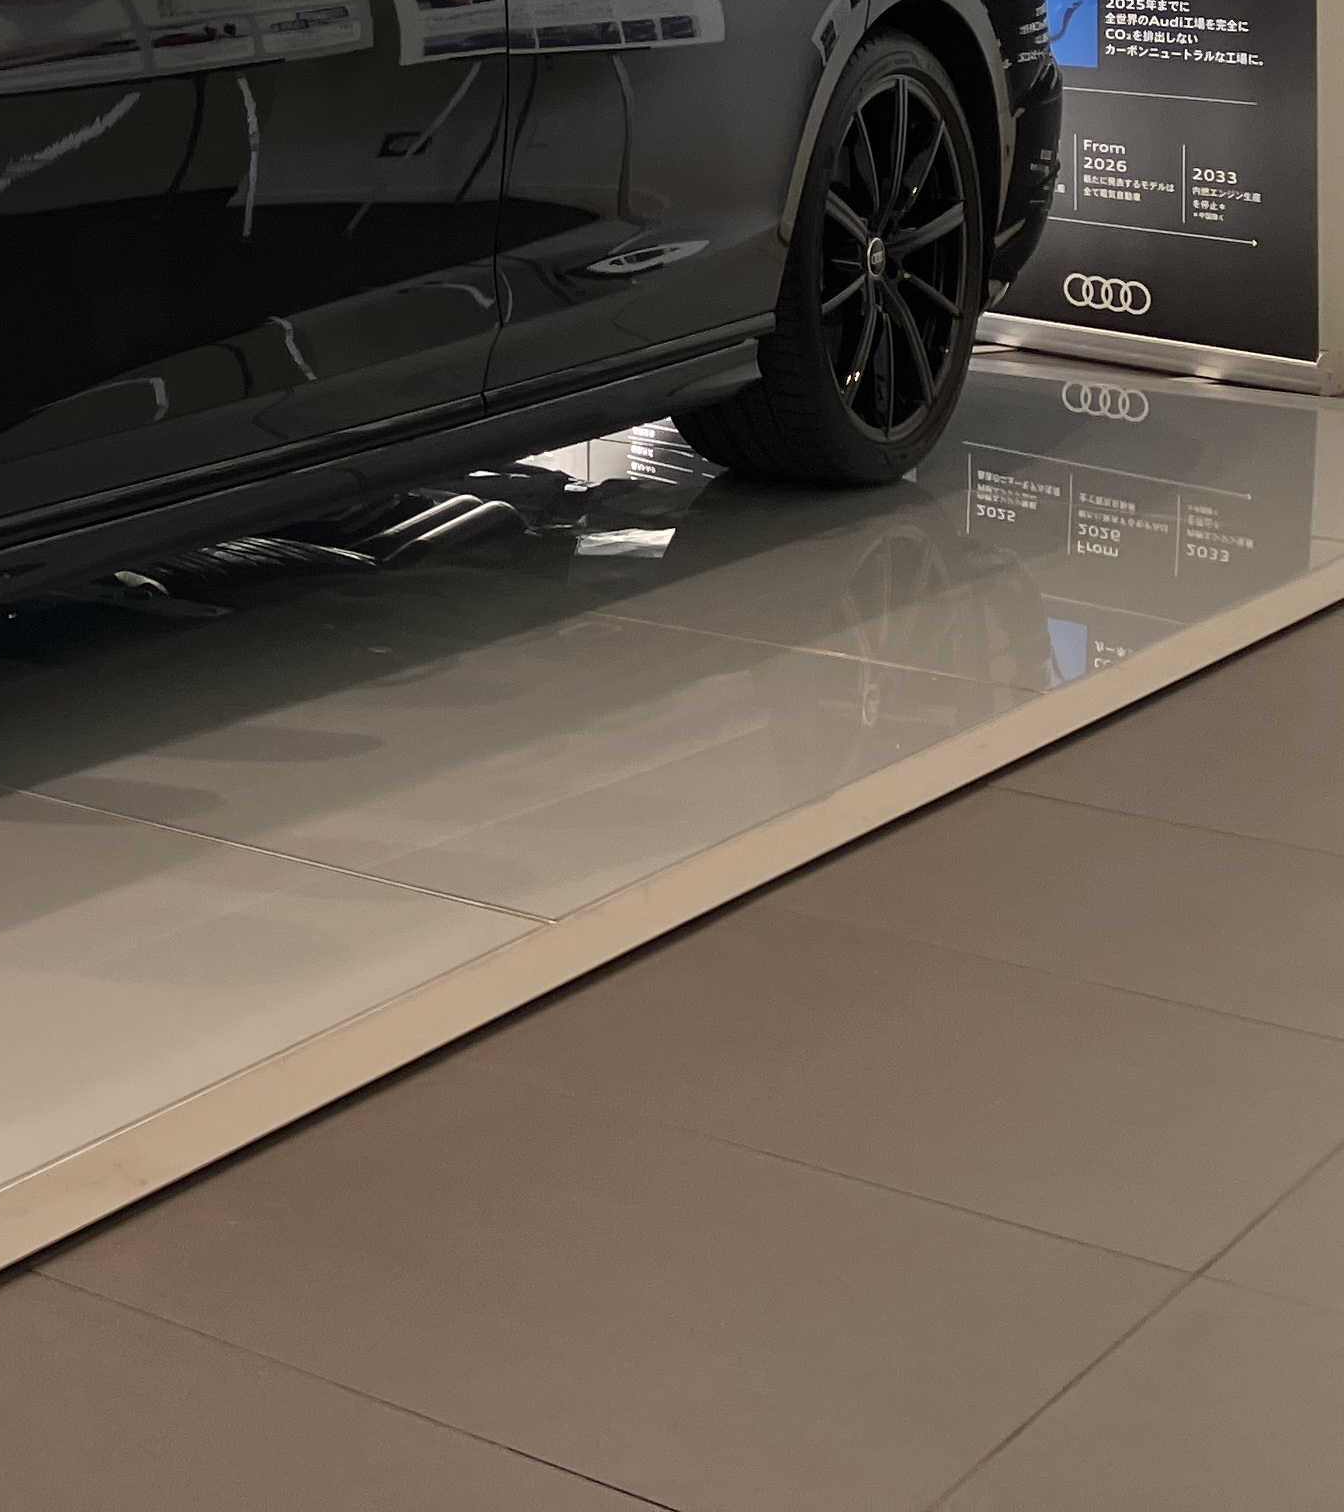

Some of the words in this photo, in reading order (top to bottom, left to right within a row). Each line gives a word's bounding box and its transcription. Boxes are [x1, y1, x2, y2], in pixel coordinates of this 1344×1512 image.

[1104, 12, 1250, 33] 全世界のAudi工場を完全に
[1105, 43, 1265, 67] カーボンニュートラルな工場に。
[1083, 139, 1126, 155] From
[1083, 156, 1128, 173] 2026
[1192, 167, 1238, 185] 2033
